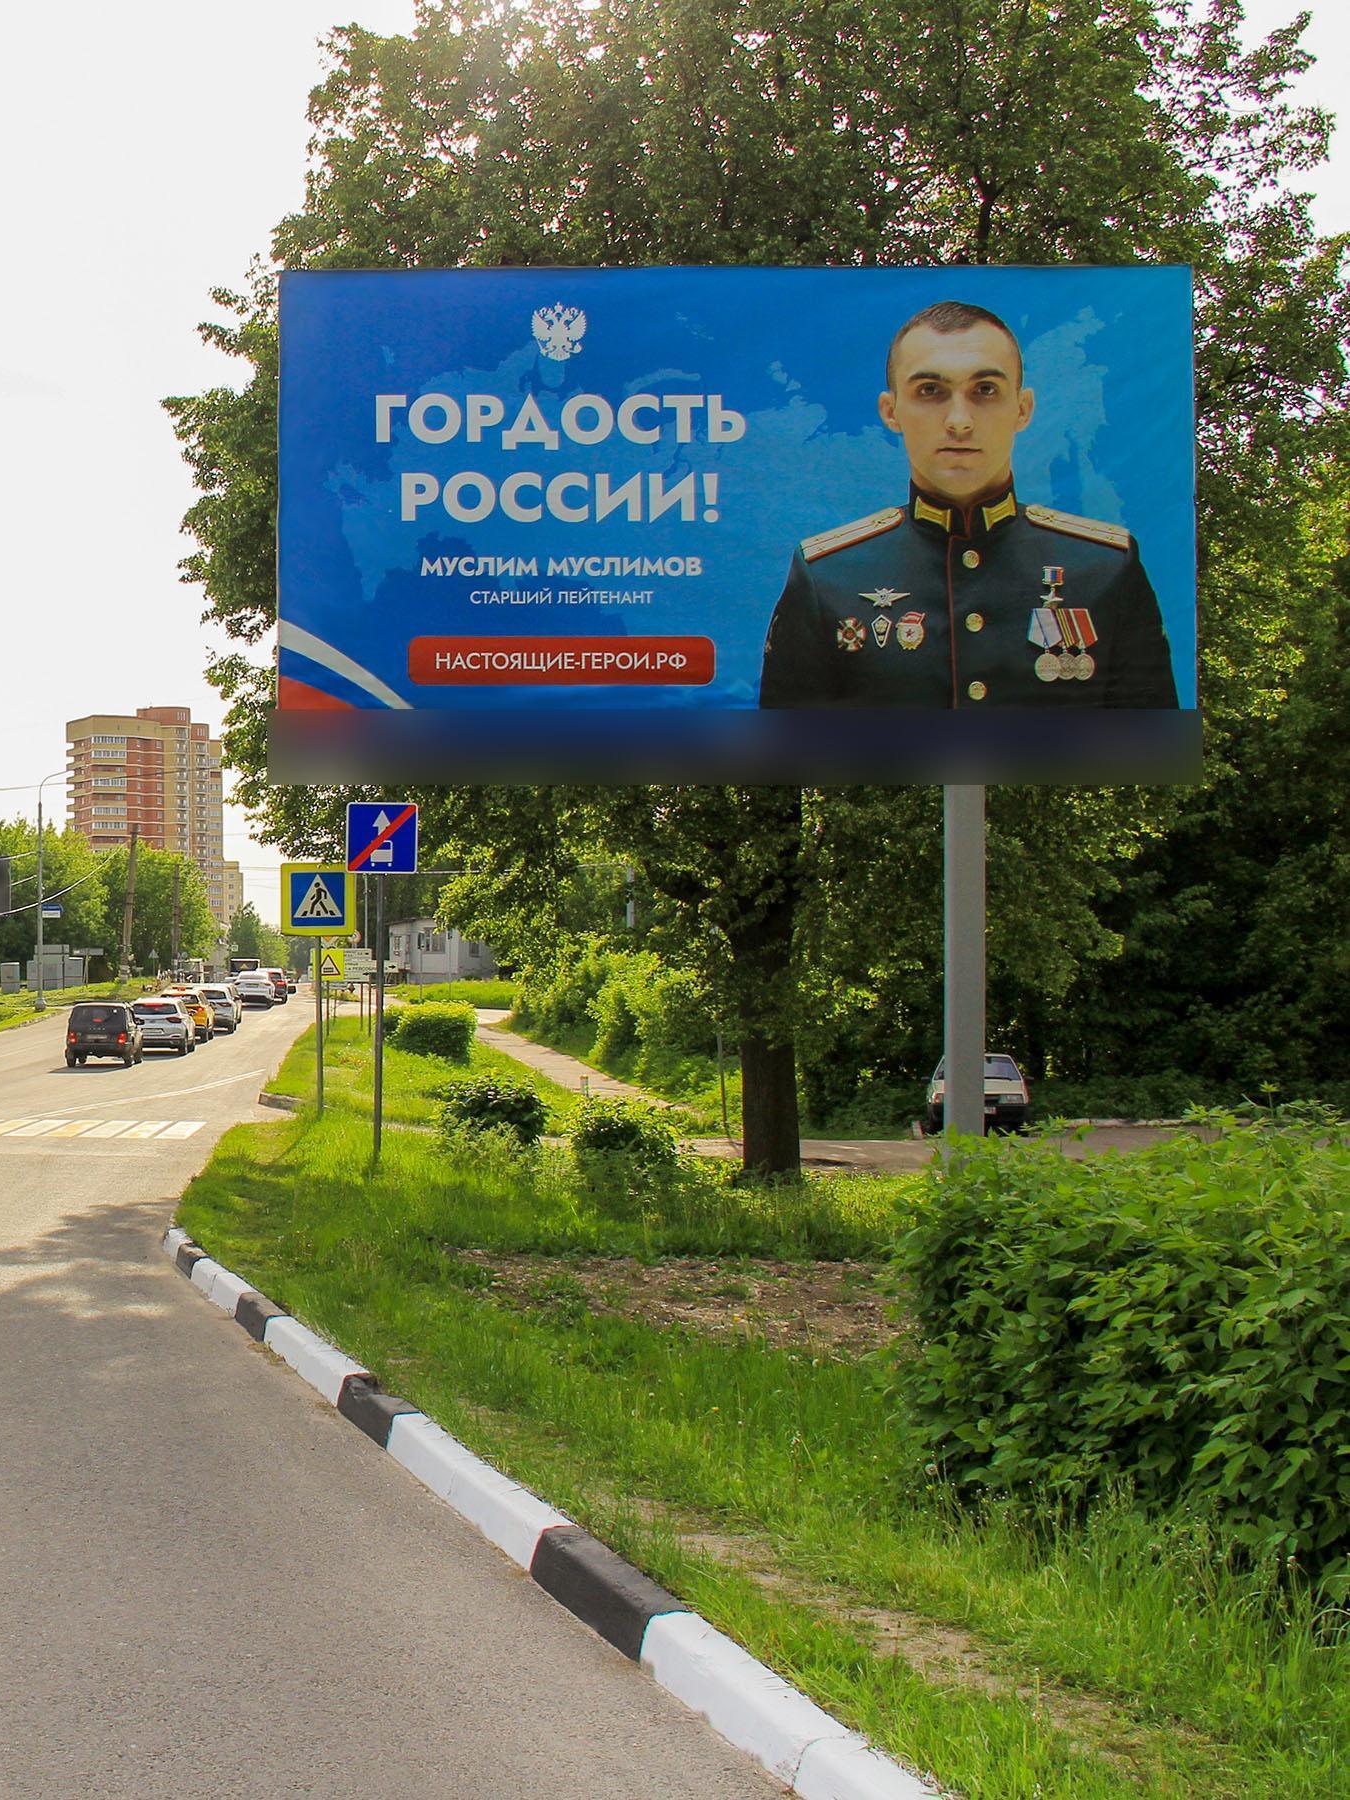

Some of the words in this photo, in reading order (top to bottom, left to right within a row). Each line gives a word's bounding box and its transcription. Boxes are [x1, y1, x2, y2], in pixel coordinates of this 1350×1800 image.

[375, 393, 747, 450] ГОРДОСТЬ
[400, 471, 720, 523] РОССИИ!
[420, 556, 539, 577] МУСЛИМ
[546, 556, 703, 577] МУСЛИМОВ
[469, 587, 552, 604] СТАРШИЙ
[557, 587, 654, 605] ЛЕЙТЕНАНТ
[435, 651, 688, 672] НАСТОЯЩИЕ-ГЕРОИ.РФ
